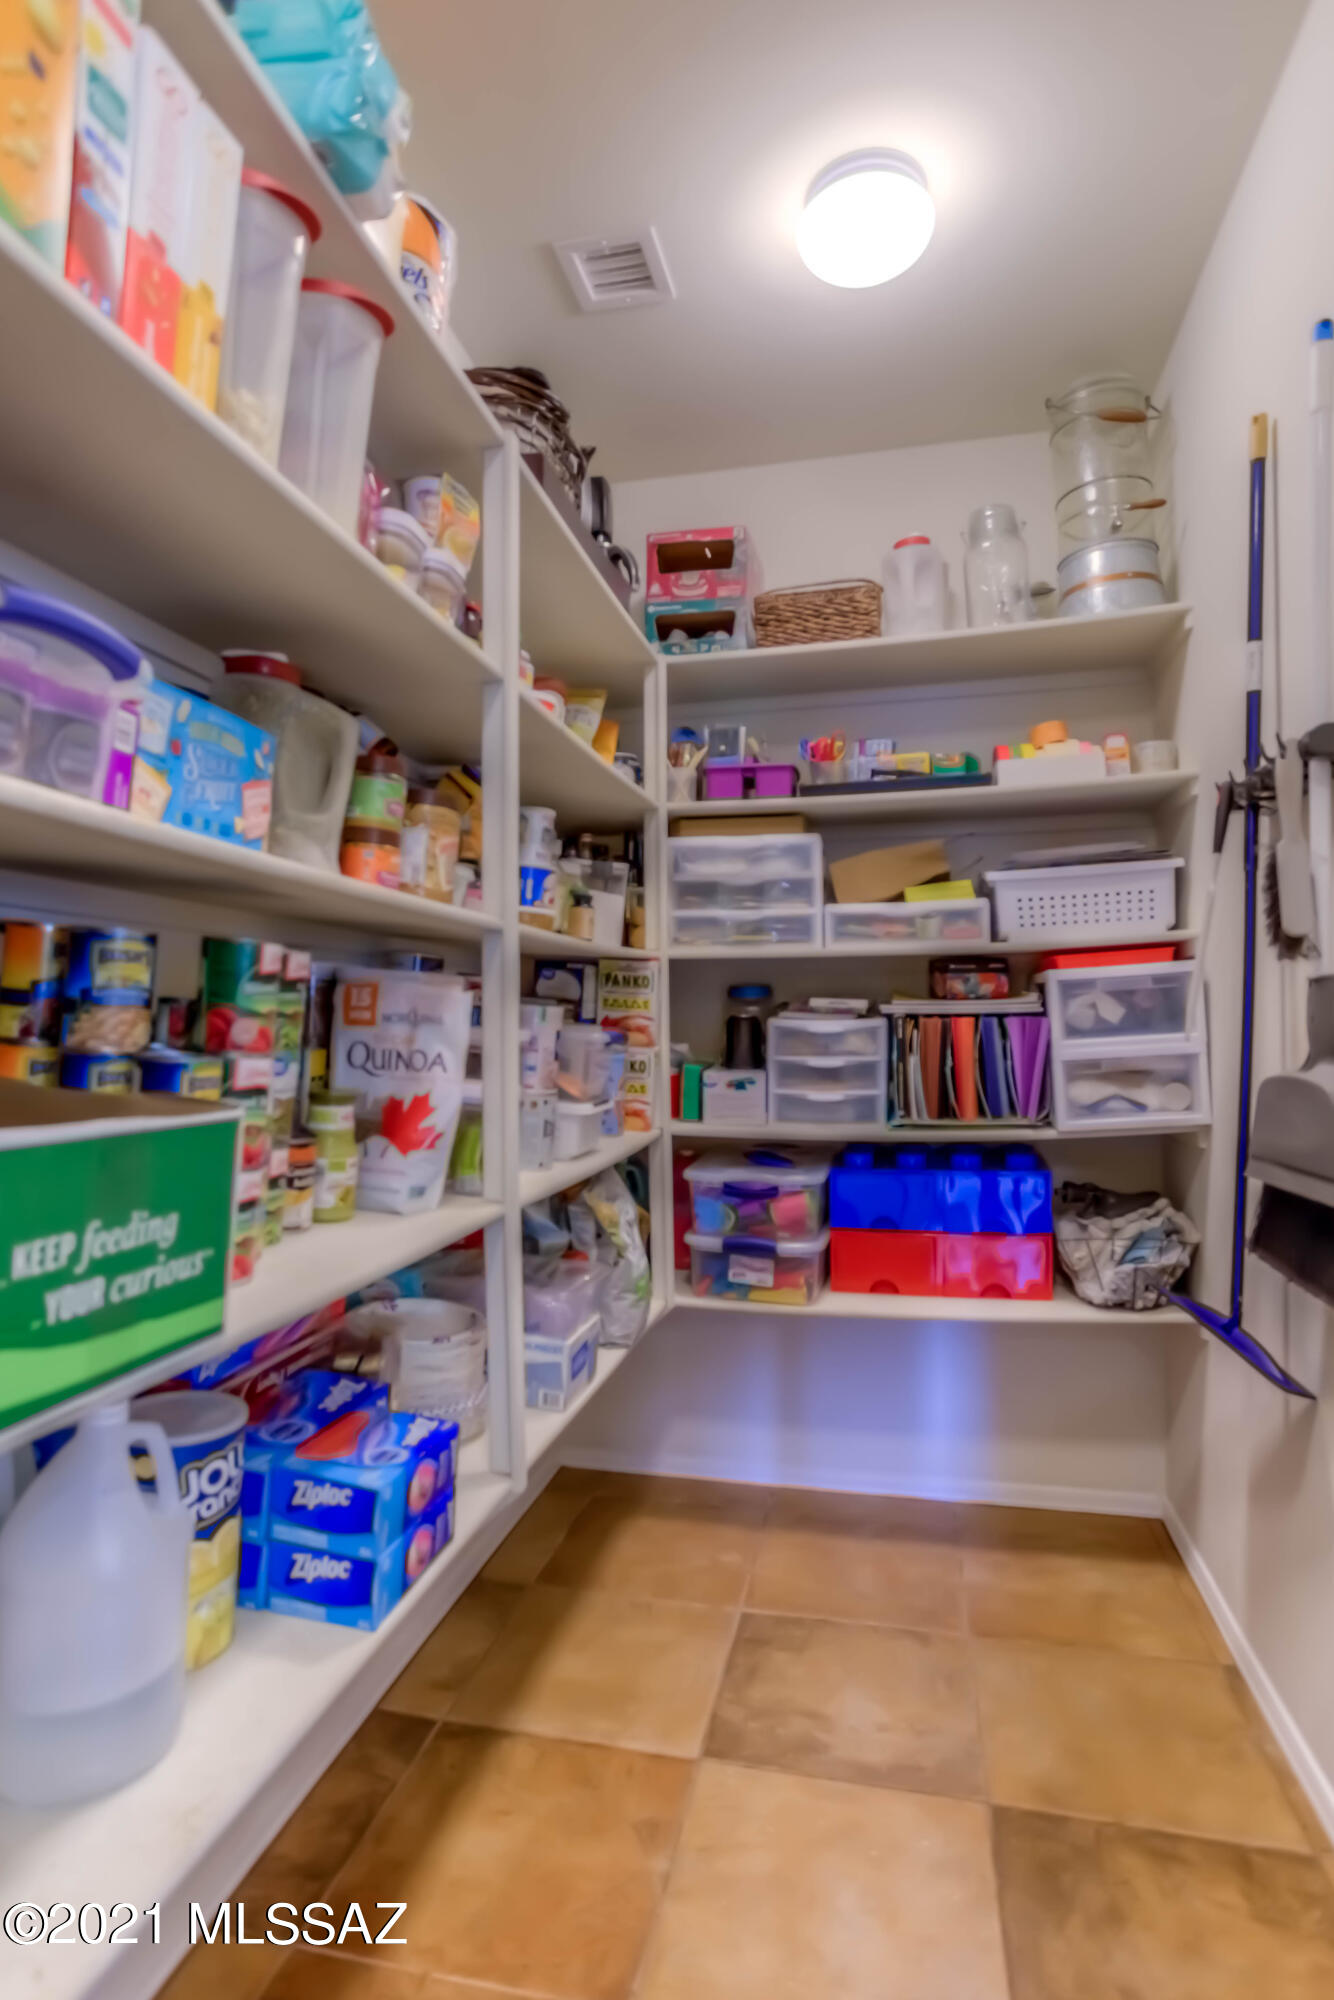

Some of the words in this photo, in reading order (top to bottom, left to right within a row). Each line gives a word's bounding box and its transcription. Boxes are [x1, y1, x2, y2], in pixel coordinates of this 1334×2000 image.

[604, 970, 651, 989] PANKO
[346, 1040, 448, 1078] QUINOA
[11, 1230, 78, 1281] KEEP
[73, 1208, 180, 1275] feeding
[44, 1274, 106, 1327] YOUR
[291, 1480, 354, 1511] Ziploc
[290, 1552, 353, 1584] Ziploc
